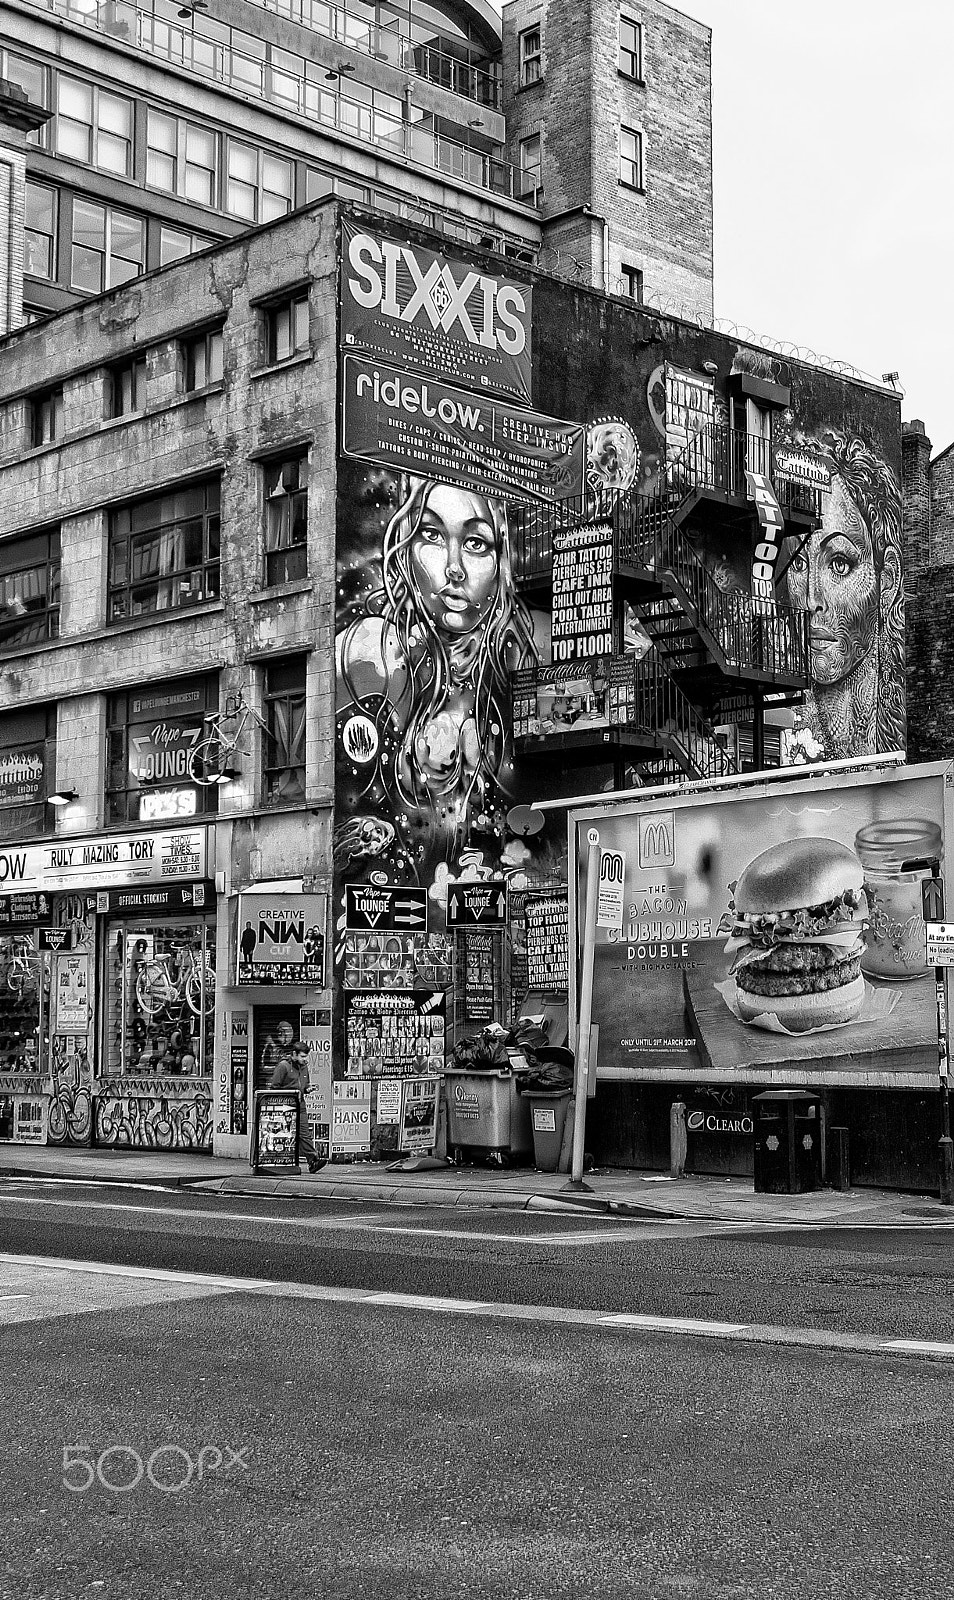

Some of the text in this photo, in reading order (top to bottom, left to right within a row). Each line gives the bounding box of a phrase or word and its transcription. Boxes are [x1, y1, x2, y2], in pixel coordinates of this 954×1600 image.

[349, 234, 526, 355] SIXXIS
[373, 319, 391, 329] CLUB
[404, 334, 489, 366] WHITWORTH STREET
[413, 344, 467, 365] MANCHESTER
[503, 417, 574, 445] CREATIVE HUB
[388, 417, 407, 430] BIKES
[415, 425, 431, 437] CAPS
[468, 441, 484, 453] HEAD
[508, 453, 548, 470] HYDROPONICS
[502, 427, 573, 457] STEP INSIDE
[413, 449, 430, 461] BODY
[431, 454, 460, 470] PIERCING
[466, 464, 482, 476] HAIR
[425, 439, 450, 456] T-SHIRT
[511, 464, 538, 480] PRINTING
[776, 455, 830, 484] Tattitude
[744, 471, 782, 580] TATTOO
[552, 545, 612, 568] 24HR TATTOO
[552, 558, 612, 581] PIERCINGS £15
[552, 572, 612, 594] CAFE INK
[752, 578, 773, 598] TOP
[552, 586, 612, 610] CHILL OUT AREA
[552, 603, 612, 624] POOL TABLE
[551, 616, 612, 637] ENTERTAINMENT
[551, 639, 575, 661] TOP
[576, 633, 612, 657] FLOOR
[719, 694, 754, 710] TATTOO &
[720, 707, 755, 725] PIERCING
[151, 723, 180, 748] Vape
[51, 839, 155, 867] RULY MAZING TORY
[363, 887, 381, 900] Vape
[648, 884, 667, 894] THE
[118, 892, 169, 907] OFFICIAL STOCKIST
[355, 898, 390, 913] LOUNGE
[464, 896, 491, 908] LOUNGE
[258, 910, 305, 920] CREATIVE
[628, 897, 687, 920] BACON
[528, 916, 544, 927] TOP
[258, 920, 305, 944] NW
[527, 926, 545, 938] 24HR
[608, 918, 712, 944] CLUBHOUSE
[928, 933, 935, 941] At
[527, 934, 559, 946] PIERCINGS
[269, 945, 293, 956] CUT
[527, 944, 552, 956] CAFE
[627, 943, 690, 960] DOUBLE
[528, 954, 545, 966] CHILL
[544, 953, 557, 964] OUT
[528, 961, 568, 974] POOL TABL
[673, 961, 696, 970] SAUCE
[528, 970, 568, 984] ENTERTAINME
[231, 1023, 247, 1036] NW
[620, 1038, 635, 1046] ONLY
[635, 1038, 652, 1046] UNTIL
[663, 1038, 684, 1046] MARCH
[684, 1038, 697, 1046] 2017
[382, 1065, 413, 1075] Piercings £15
[334, 1111, 369, 1124] HANG
[334, 1124, 360, 1136] OVER
